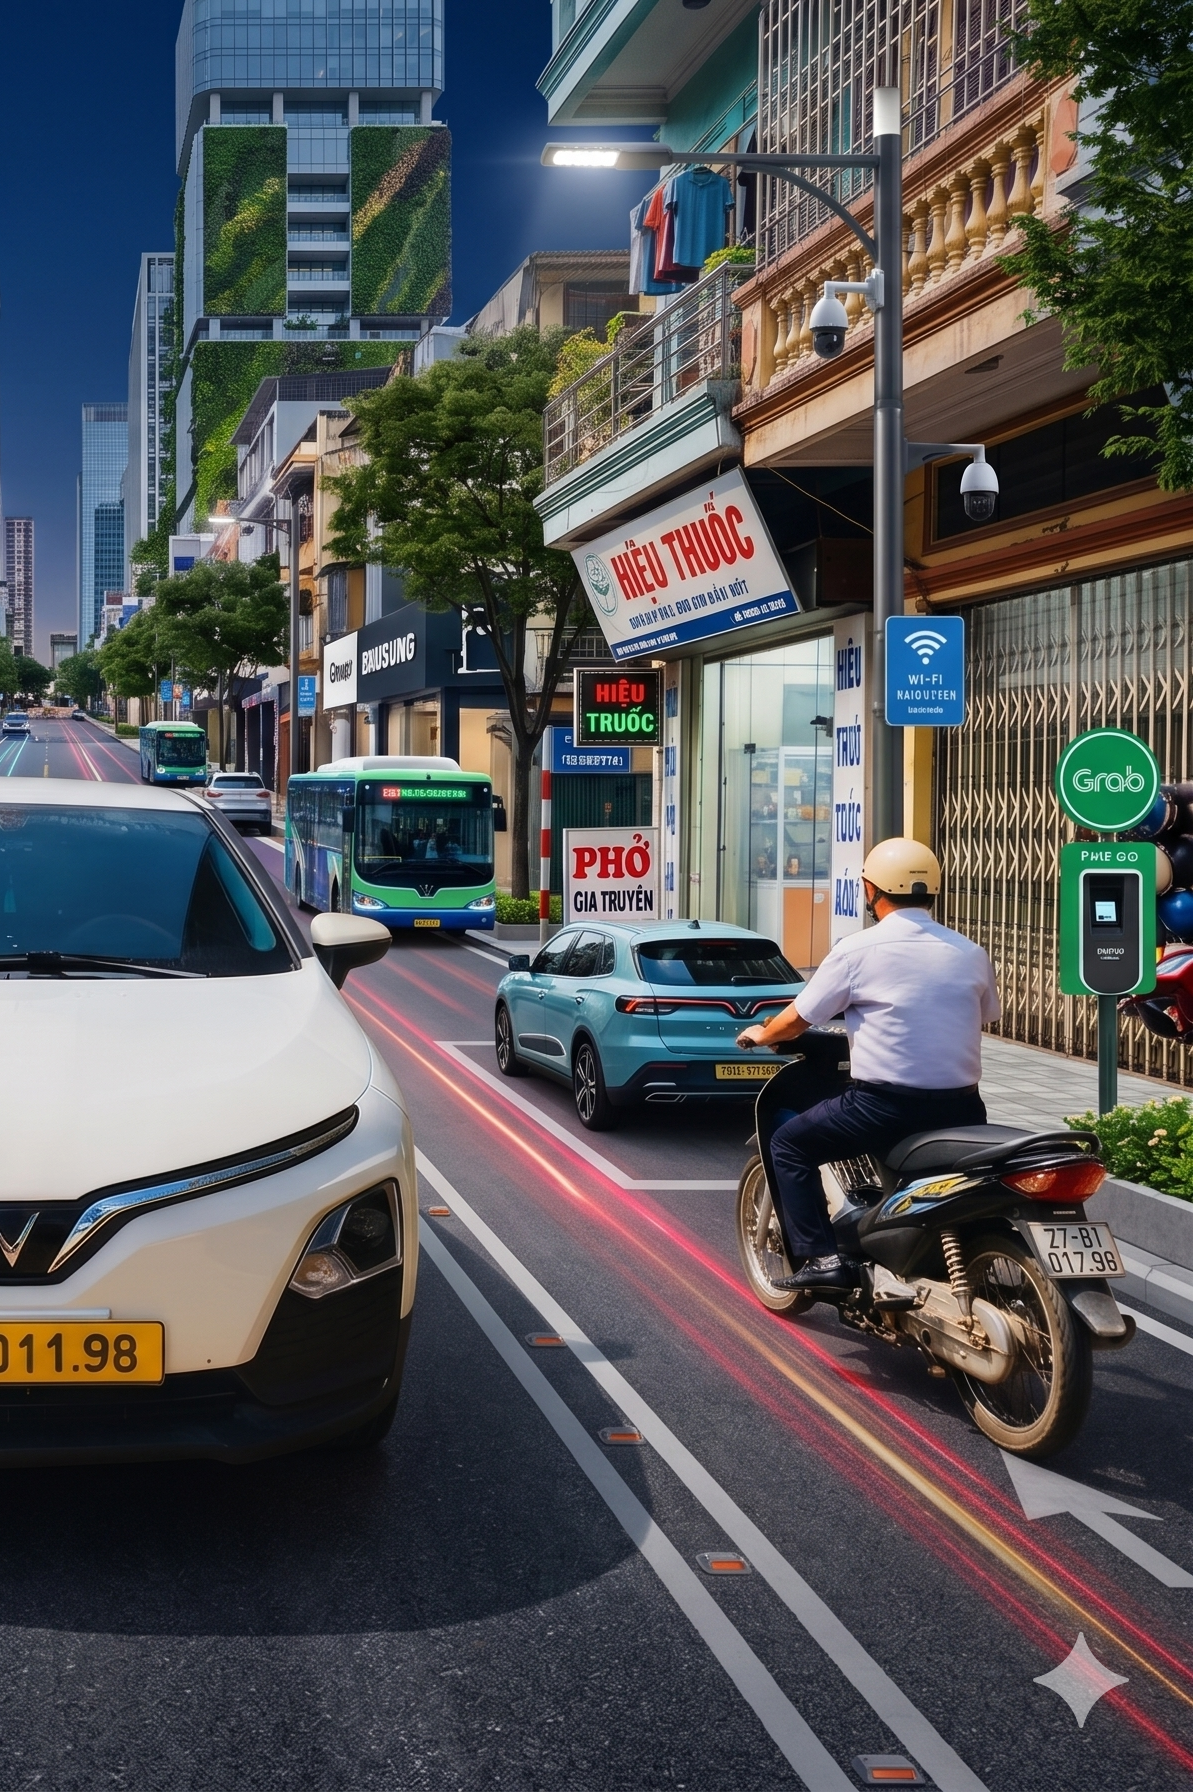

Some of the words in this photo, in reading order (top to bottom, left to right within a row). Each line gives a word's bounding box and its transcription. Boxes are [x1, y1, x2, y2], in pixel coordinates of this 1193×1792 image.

[1072, 765, 1145, 793] Grab
[572, 833, 651, 879] PHỞ
[574, 890, 598, 912] GIA
[1047, 1251, 1118, 1273] 017.96
